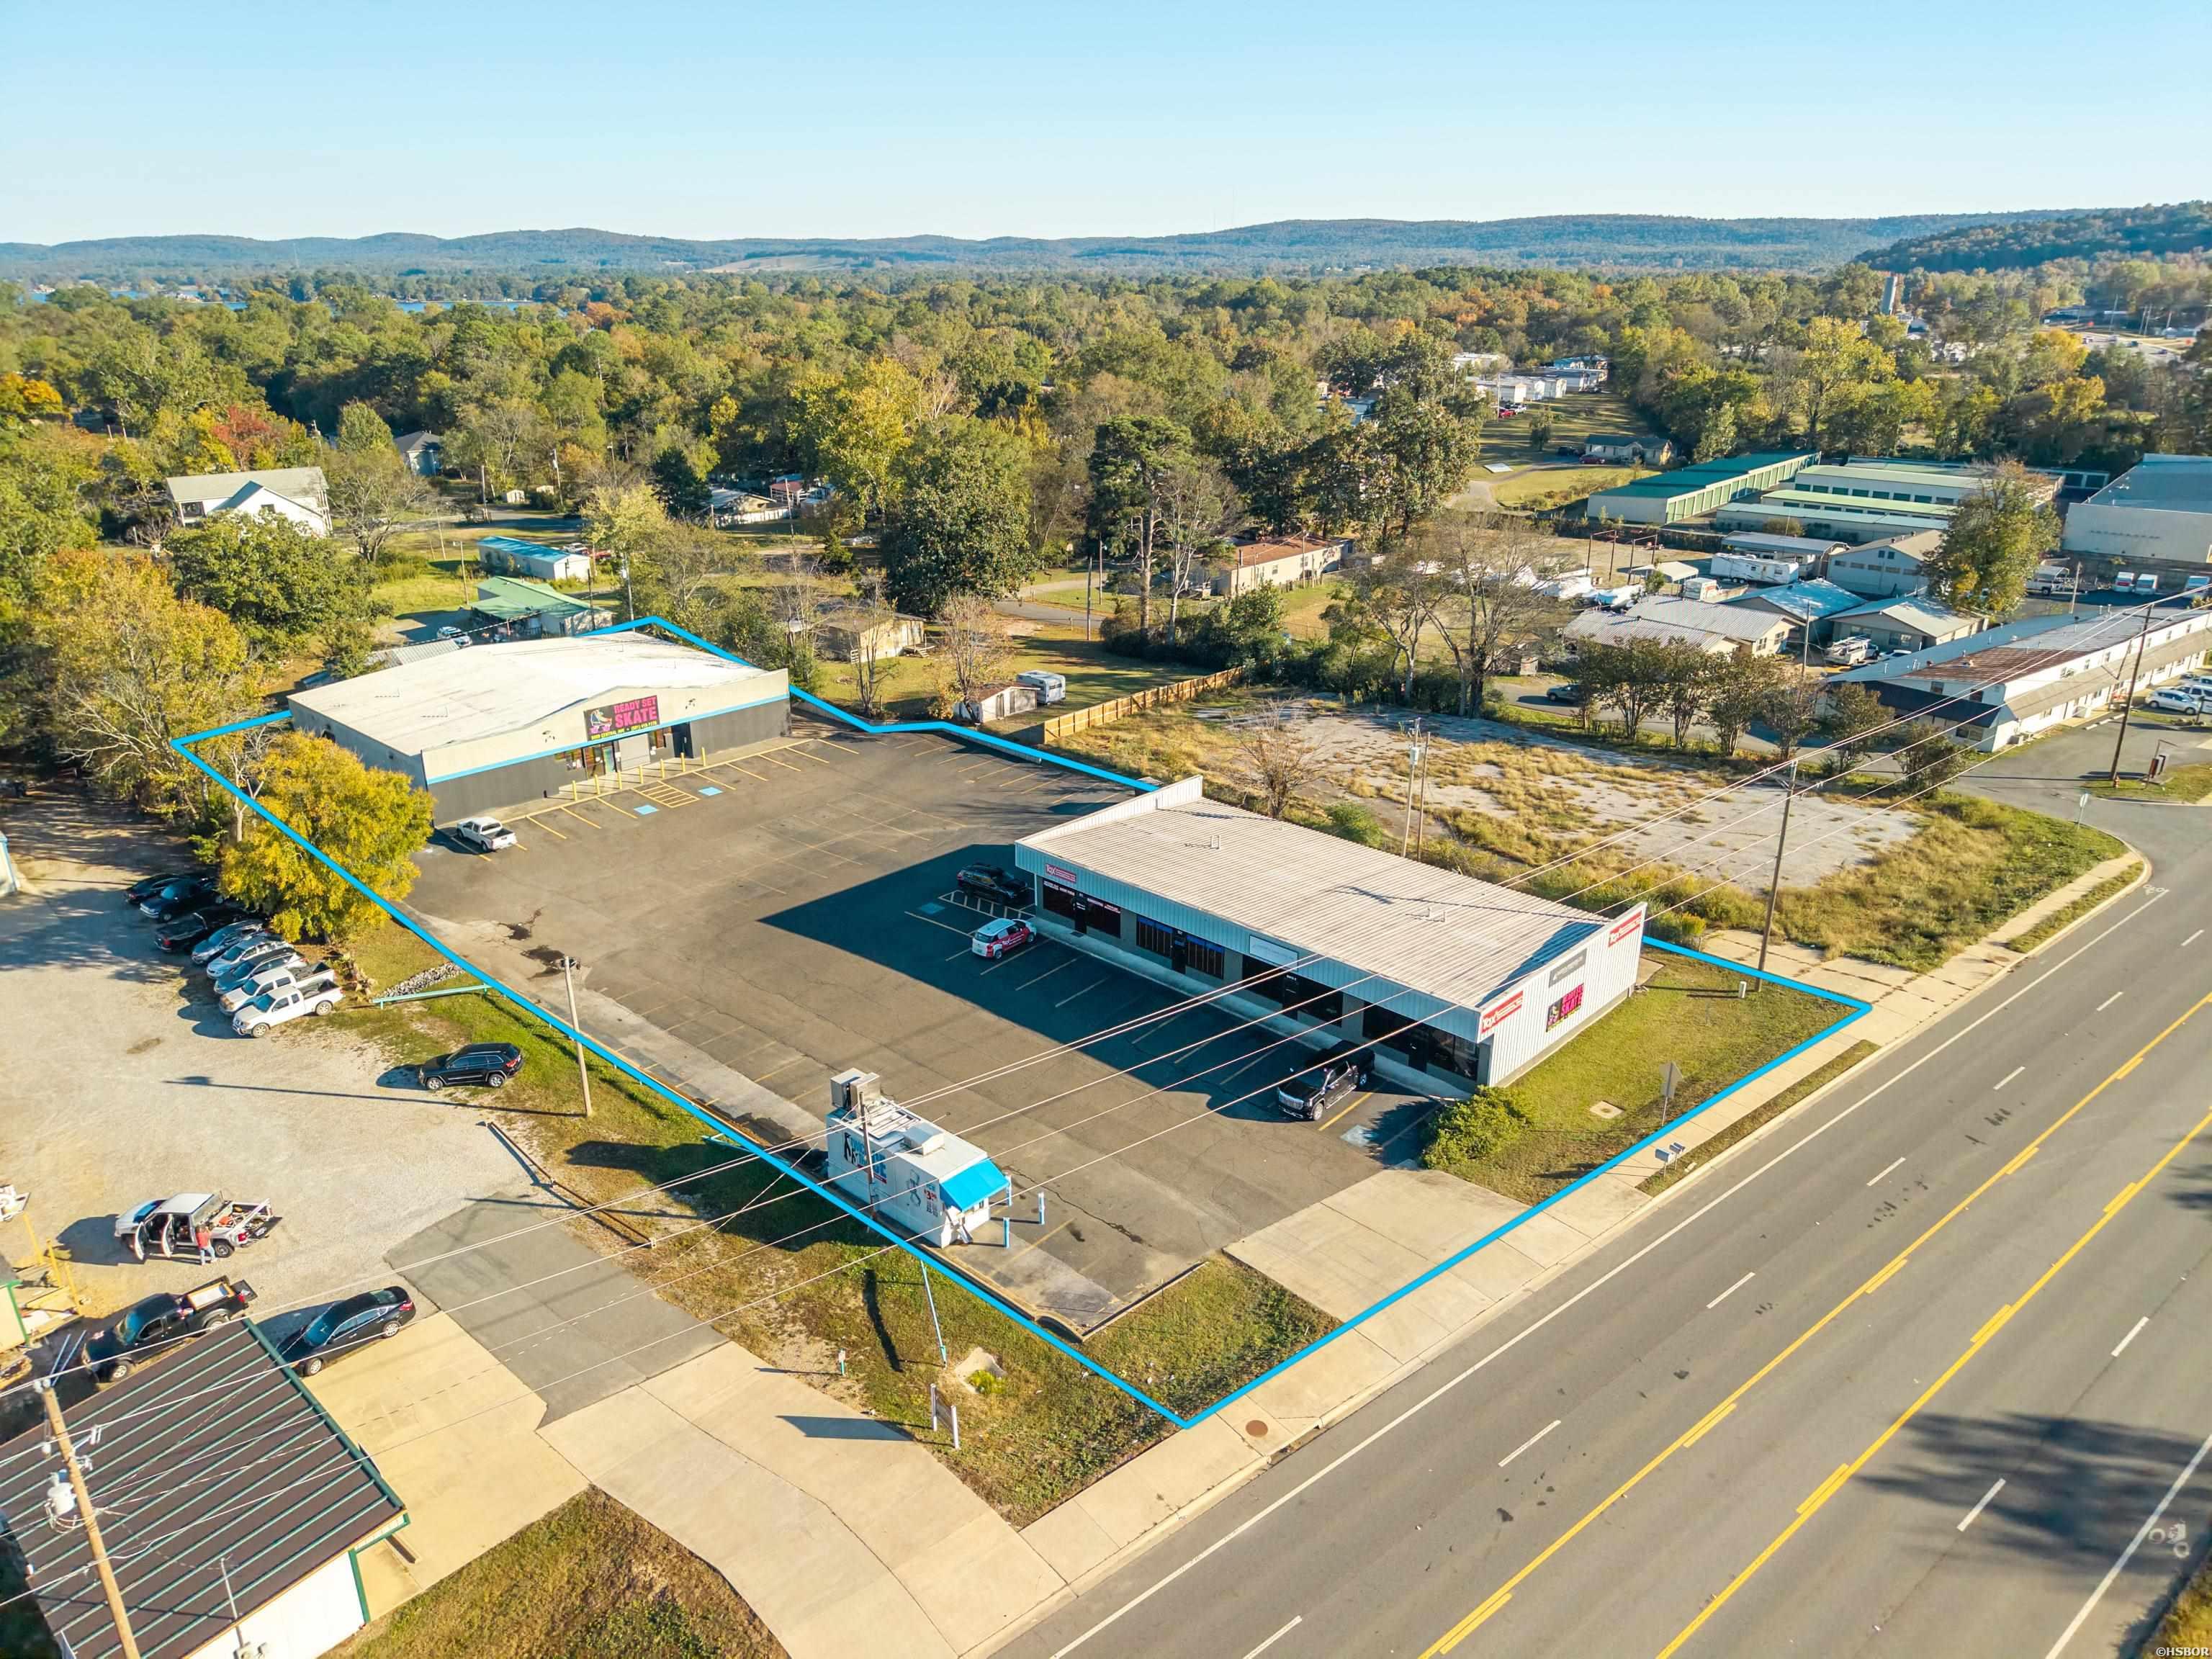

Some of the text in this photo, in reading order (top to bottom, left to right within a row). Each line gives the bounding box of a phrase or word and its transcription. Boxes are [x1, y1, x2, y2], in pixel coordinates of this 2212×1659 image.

[614, 697, 656, 713] READY SET
[616, 707, 657, 727] SKATE
